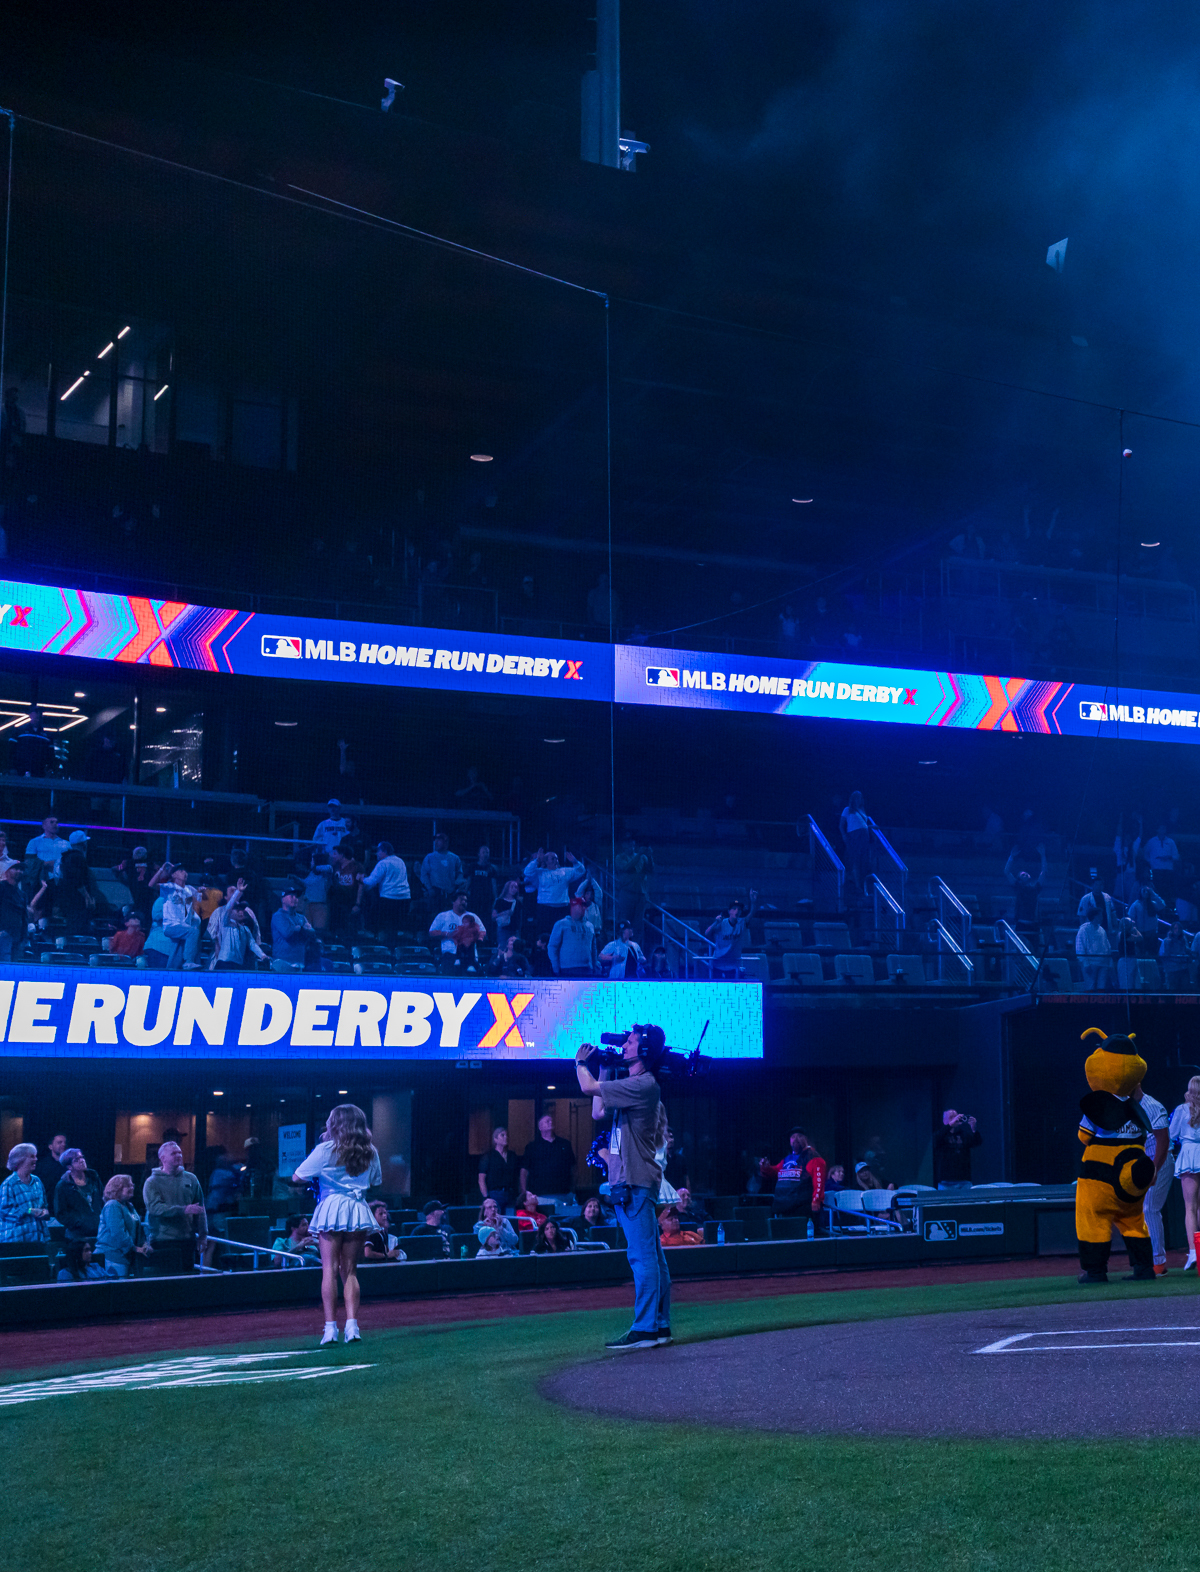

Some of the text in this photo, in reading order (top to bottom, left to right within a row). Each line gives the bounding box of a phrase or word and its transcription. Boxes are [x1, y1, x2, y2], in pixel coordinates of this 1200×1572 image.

[305, 639, 356, 662] MLB
[359, 643, 433, 668] HOME
[433, 649, 485, 673] RUN
[683, 669, 726, 691] MLB
[728, 674, 792, 696] HOME
[791, 678, 836, 700] RUN
[1109, 704, 1145, 723] MLB
[1147, 708, 1198, 727] HOME
[0, 981, 65, 1043] E
[66, 983, 233, 1047] RUN
